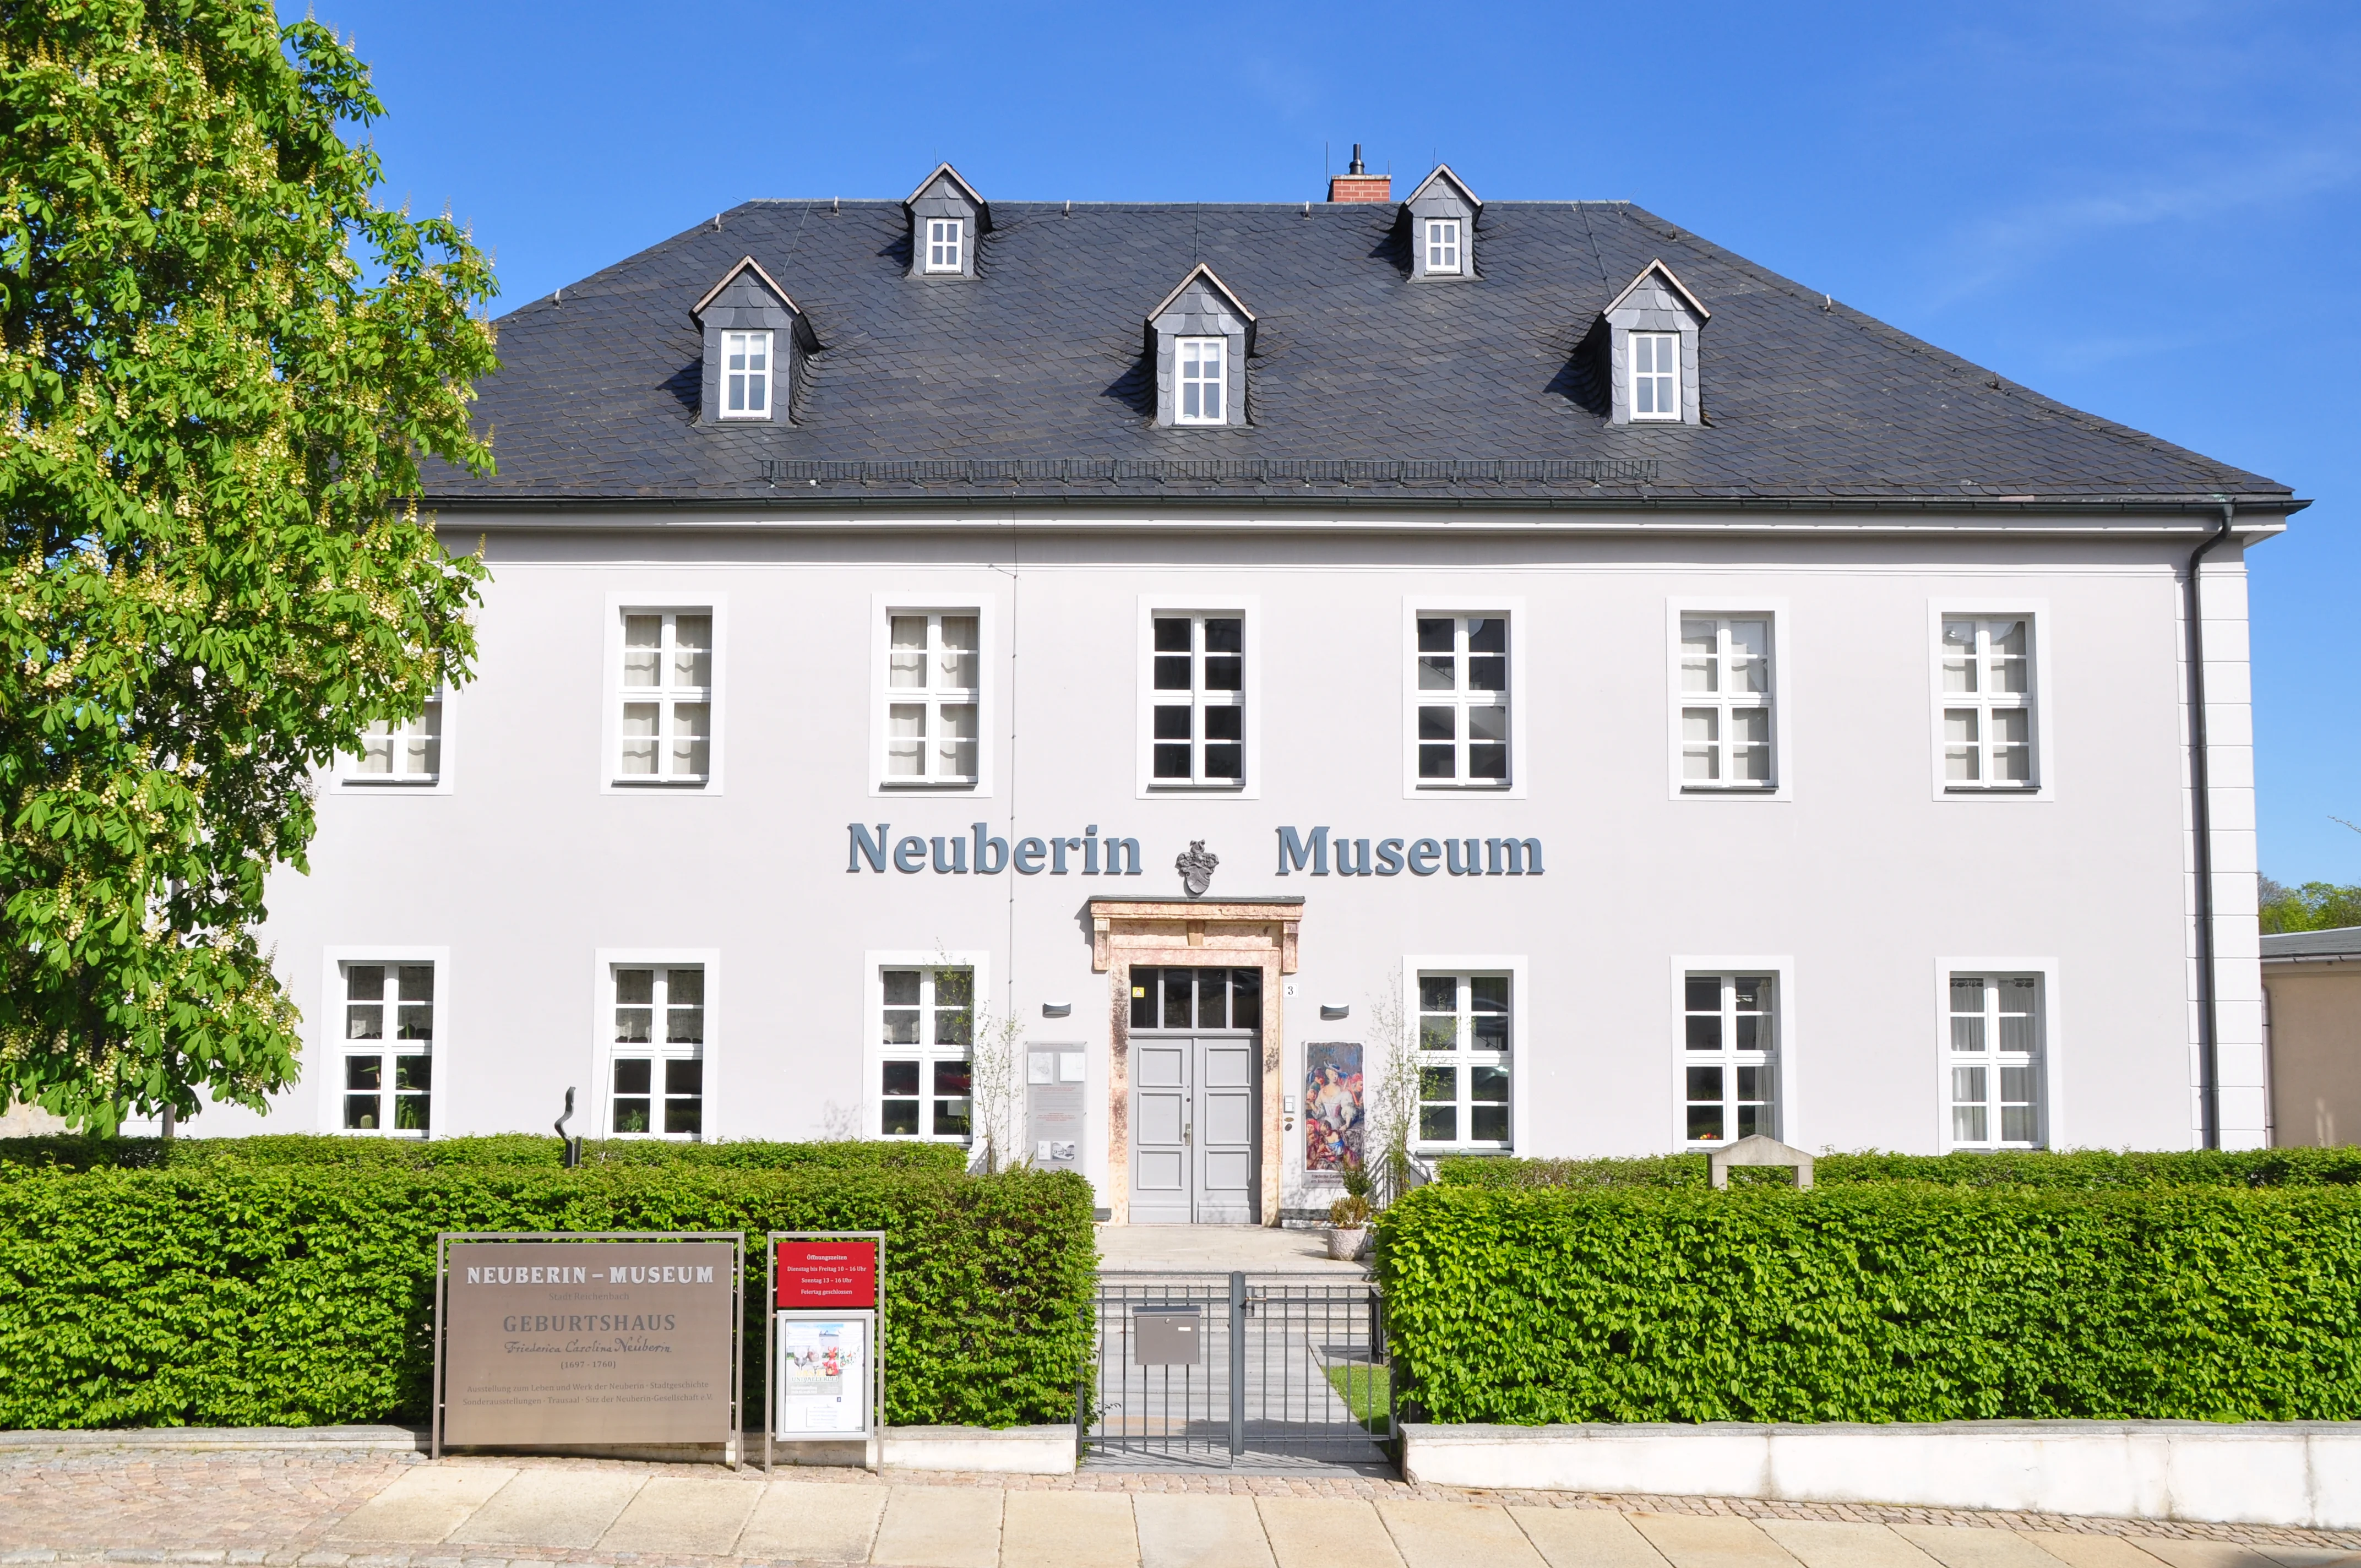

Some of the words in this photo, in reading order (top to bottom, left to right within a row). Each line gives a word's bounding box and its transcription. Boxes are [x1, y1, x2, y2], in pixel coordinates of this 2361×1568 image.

[846, 822, 1143, 875] Neuberin
[1275, 826, 1546, 876] Museum
[1288, 986, 1293, 995] 3
[467, 1267, 586, 1284] NEUBERIN
[610, 1266, 714, 1284] MUSEUM
[548, 1292, 571, 1300] Stadt
[574, 1292, 629, 1300] Reichenbach
[503, 1314, 676, 1332] GEBURTSHAUS
[504, 1341, 561, 1353] Friederica
[565, 1338, 612, 1353] Carolina
[561, 1360, 585, 1370] (1697
[592, 1360, 616, 1369] 1760)
[467, 1385, 511, 1393] Ausstellung
[650, 1381, 709, 1390] Stadtgeschichte
[463, 1397, 541, 1406] Sonderausstellungen
[616, 1393, 699, 1403] Neuberin-Gesellschaft
